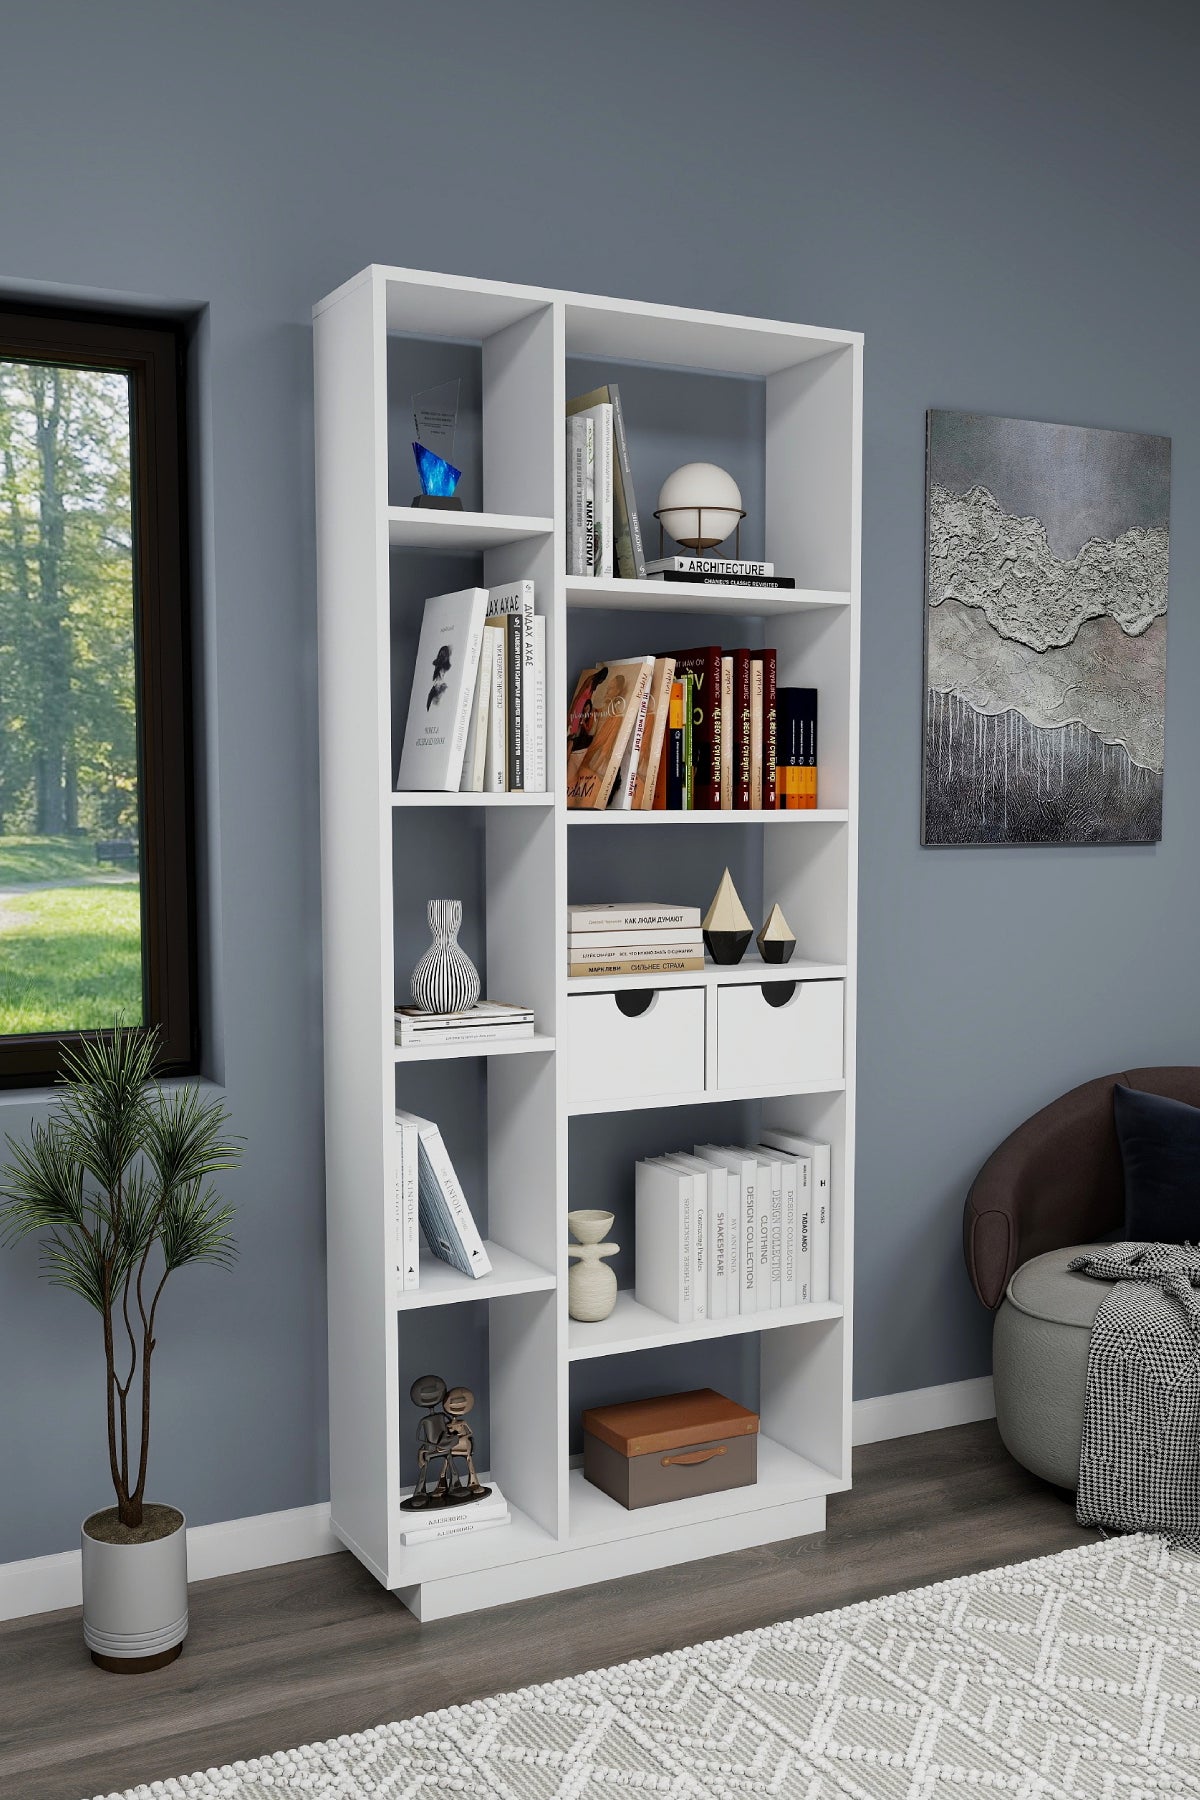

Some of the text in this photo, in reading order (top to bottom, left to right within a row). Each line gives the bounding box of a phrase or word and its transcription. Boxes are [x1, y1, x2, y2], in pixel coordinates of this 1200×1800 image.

[688, 560, 765, 576] ARCHITECTURE
[638, 916, 656, 924] ЛЮДИ
[588, 960, 685, 973] МАРК ЛЕВИ СИЛЬНЕЕ СТРАХА
[444, 1179, 464, 1216] KINFOLK
[746, 1186, 754, 1289] DESIGN COLLECTION
[760, 1215, 769, 1265] CLOTHING
[771, 1190, 781, 1282] DESIGN COLLECTION
[786, 1190, 794, 1282] DESIGN COLLECTION
[801, 1212, 809, 1234] TADAO
[716, 1212, 725, 1277] SHAKESPEARE
[801, 1235, 809, 1252] ANDO
